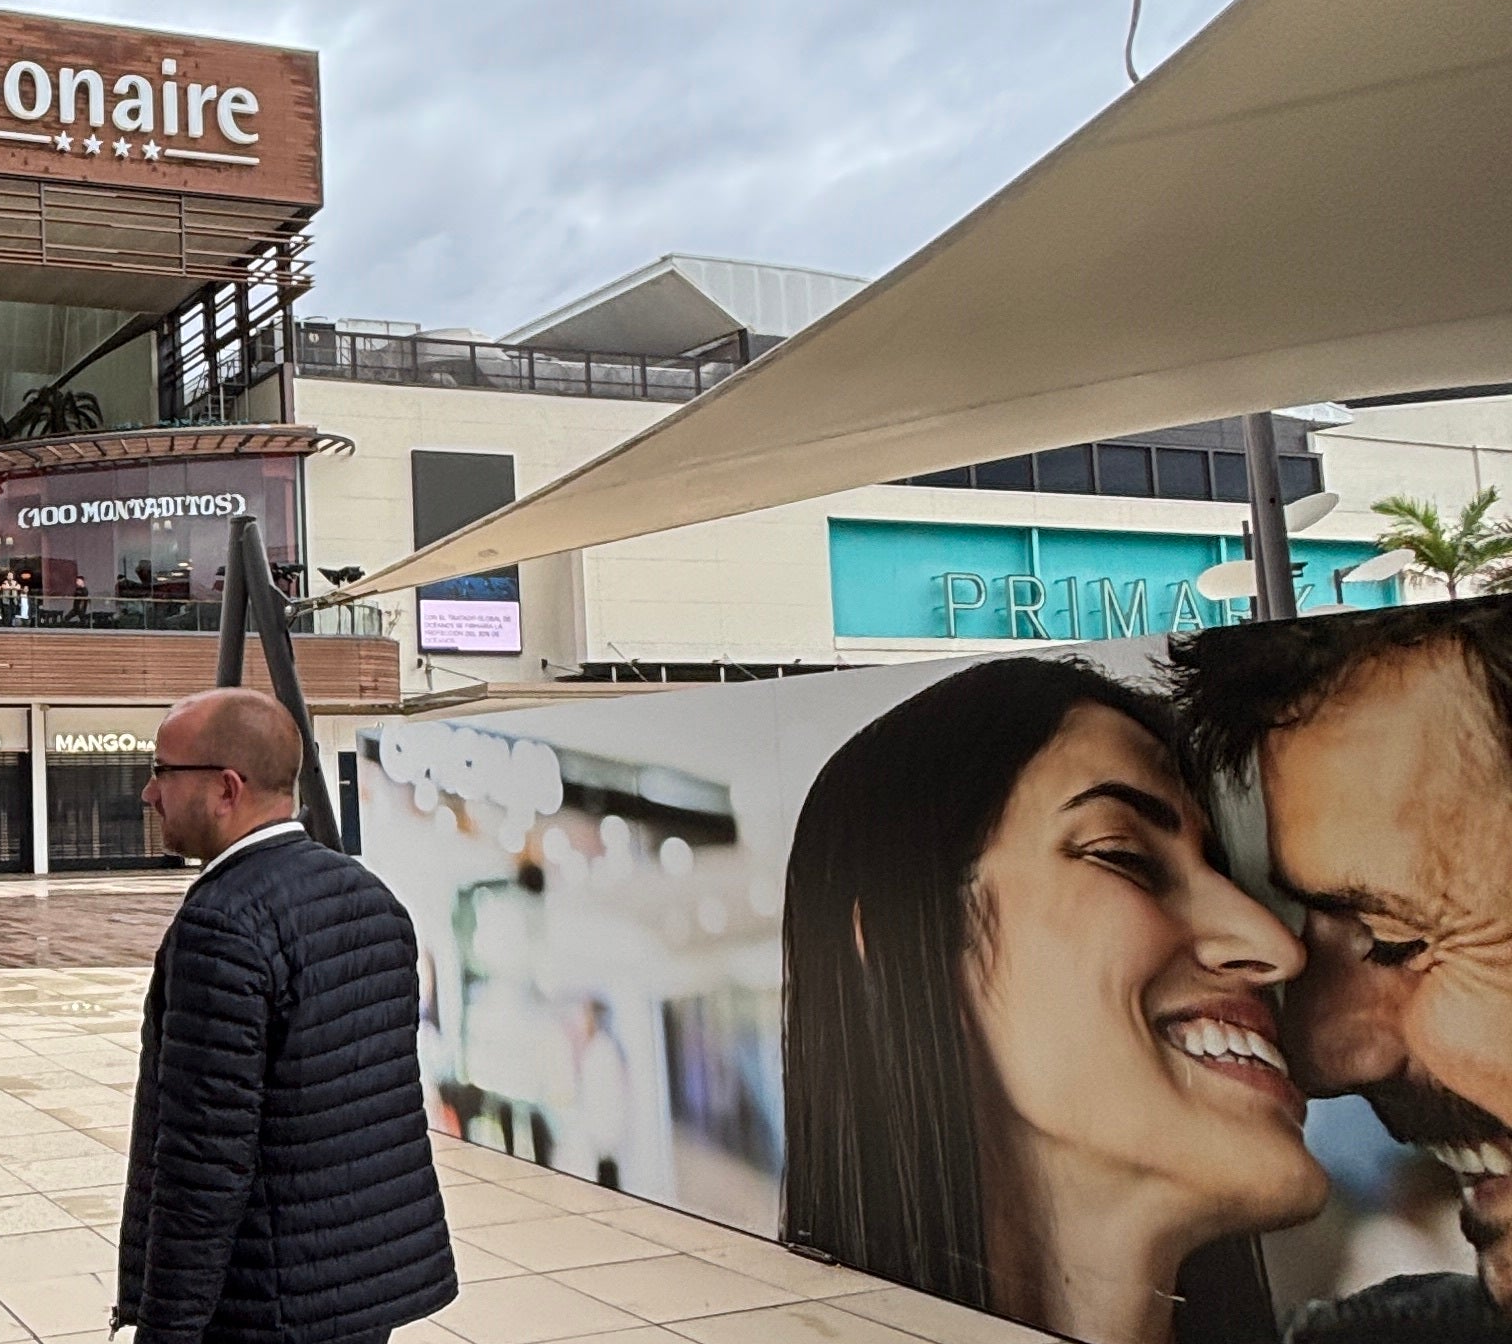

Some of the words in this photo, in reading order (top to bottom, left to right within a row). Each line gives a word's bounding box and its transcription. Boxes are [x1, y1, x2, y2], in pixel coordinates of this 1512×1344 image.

[17, 504, 77, 529] (100
[80, 493, 246, 524] MONTADITOS)
[55, 733, 136, 752] MANGO
